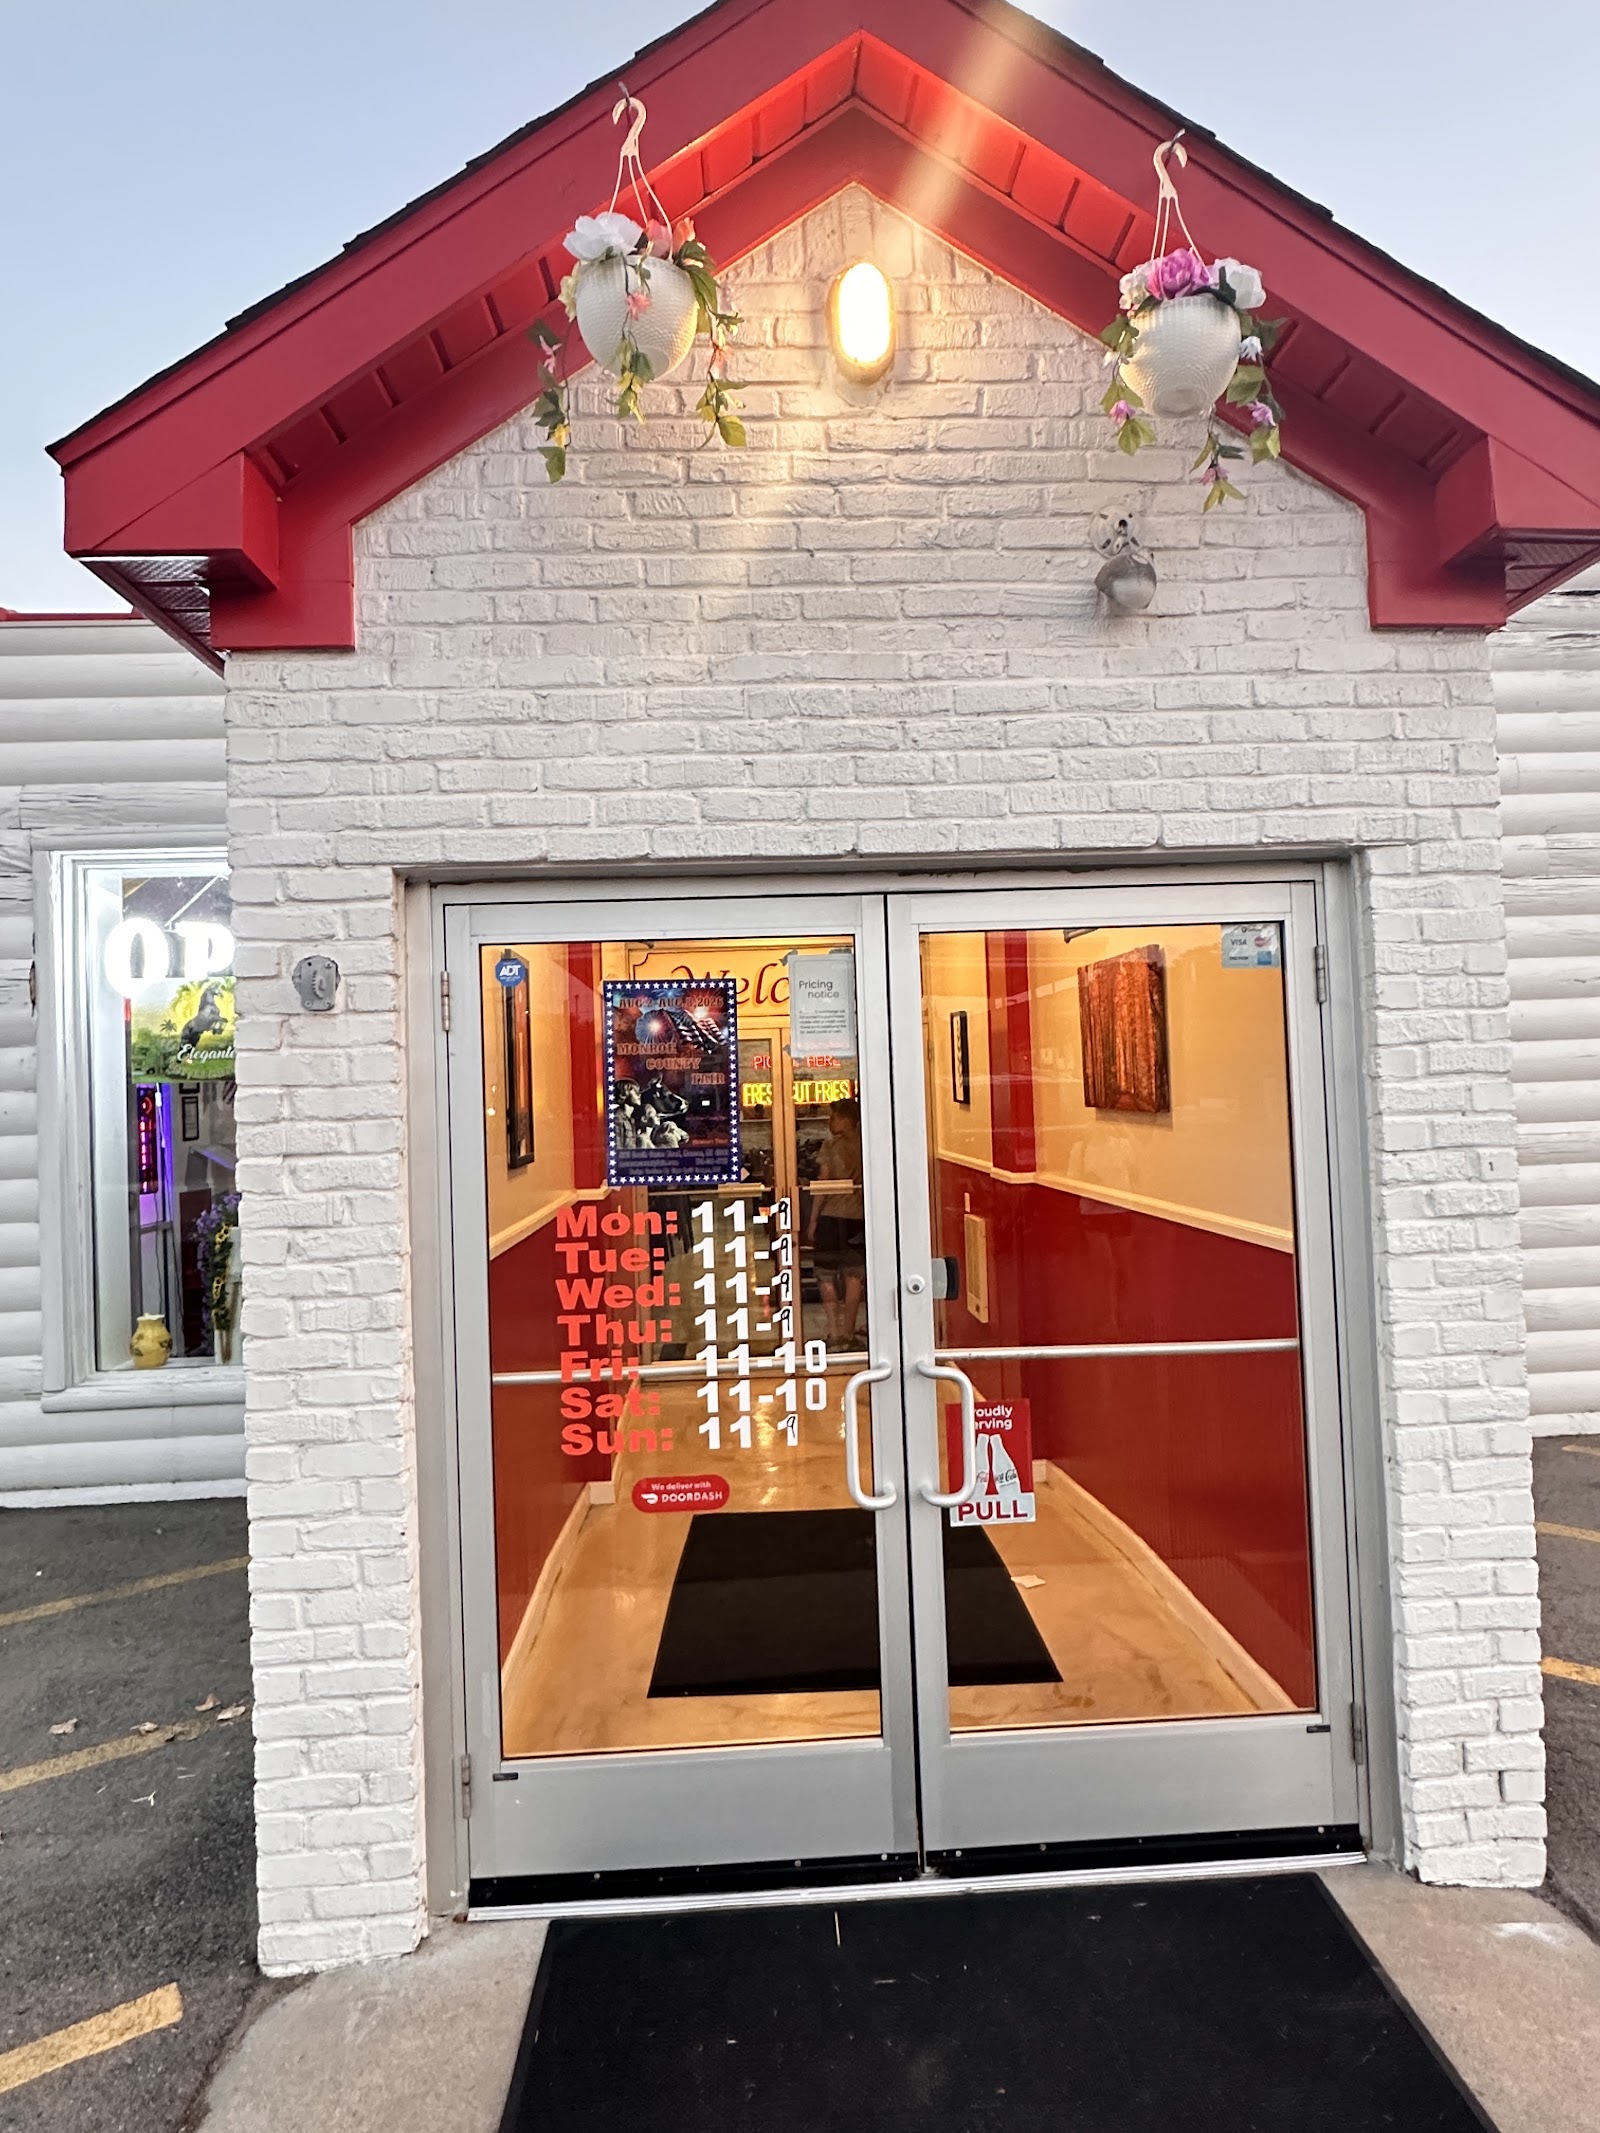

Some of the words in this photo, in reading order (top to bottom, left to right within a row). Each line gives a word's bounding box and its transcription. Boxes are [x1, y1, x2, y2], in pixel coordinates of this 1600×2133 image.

[499, 964, 521, 977] ADT
[798, 979, 833, 991] Pricing
[808, 990, 840, 999] notice
[617, 1043, 677, 1055] MONROE
[646, 1057, 701, 1070] COUNTY
[815, 1080, 850, 1102] FRIES
[556, 1205, 678, 1238] Mon:
[555, 1242, 666, 1274] Tue:
[555, 1276, 682, 1310] Wed:
[557, 1314, 673, 1346] Thu:
[560, 1350, 640, 1383] Fri:
[696, 1339, 828, 1377] 11-10
[560, 1387, 661, 1419] Sat:
[697, 1378, 828, 1413] 11-10
[975, 1405, 1013, 1418] oudly
[975, 1418, 1012, 1430] rving
[561, 1423, 673, 1456] Sun:
[651, 1483, 665, 1491] We
[666, 1482, 693, 1490] deliver
[661, 1491, 722, 1503] DOORDASH
[958, 1500, 1028, 1521] PULL
